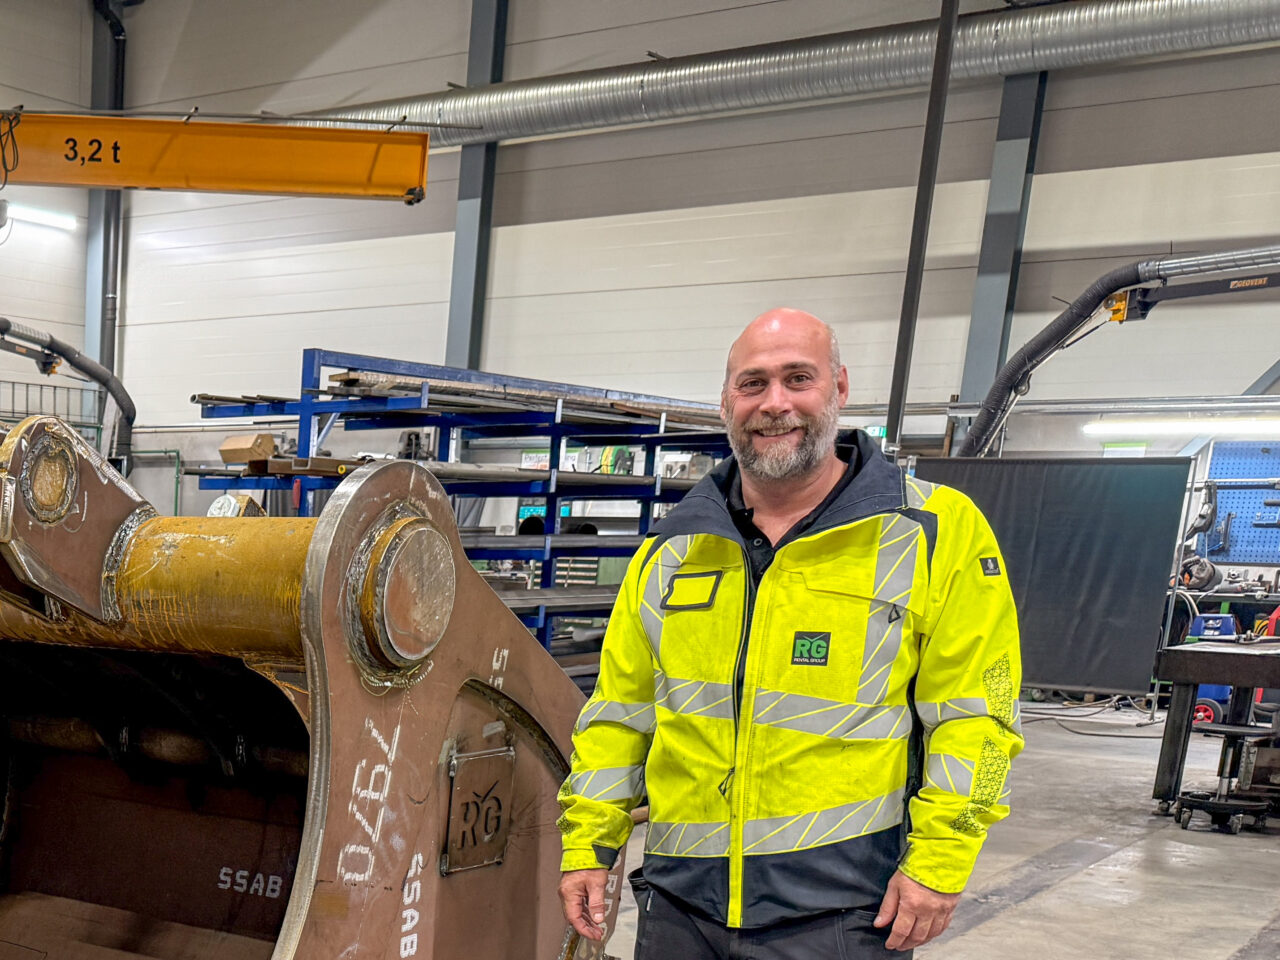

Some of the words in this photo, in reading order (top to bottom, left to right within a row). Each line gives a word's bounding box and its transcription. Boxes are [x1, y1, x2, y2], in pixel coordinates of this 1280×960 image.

[64, 137, 102, 166] 3,2
[111, 141, 121, 163] t
[794, 640, 827, 657] RG
[457, 796, 502, 849] RG
[217, 866, 283, 898] SSAB
[399, 852, 424, 960] SSAB
